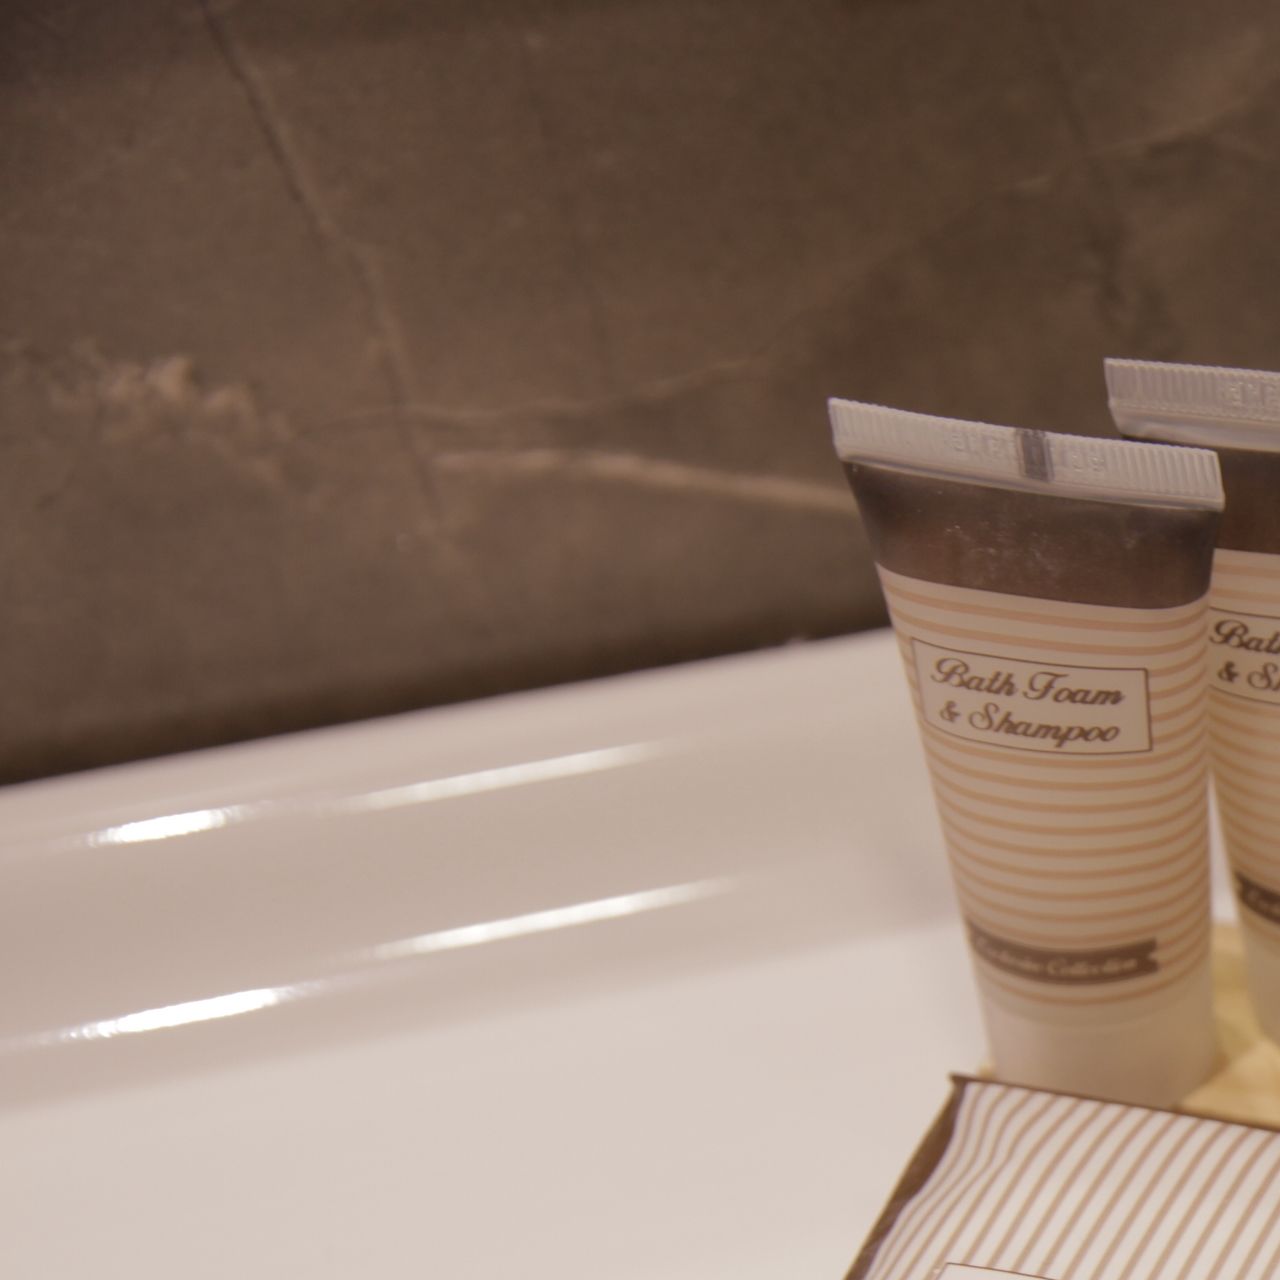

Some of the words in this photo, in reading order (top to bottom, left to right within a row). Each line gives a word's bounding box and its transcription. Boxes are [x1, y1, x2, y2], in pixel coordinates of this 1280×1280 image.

[931, 657, 1017, 697] Bath
[1022, 671, 1125, 705] Foam
[1218, 661, 1239, 683] &
[940, 701, 960, 723] &
[968, 703, 1120, 748] Shampoo
